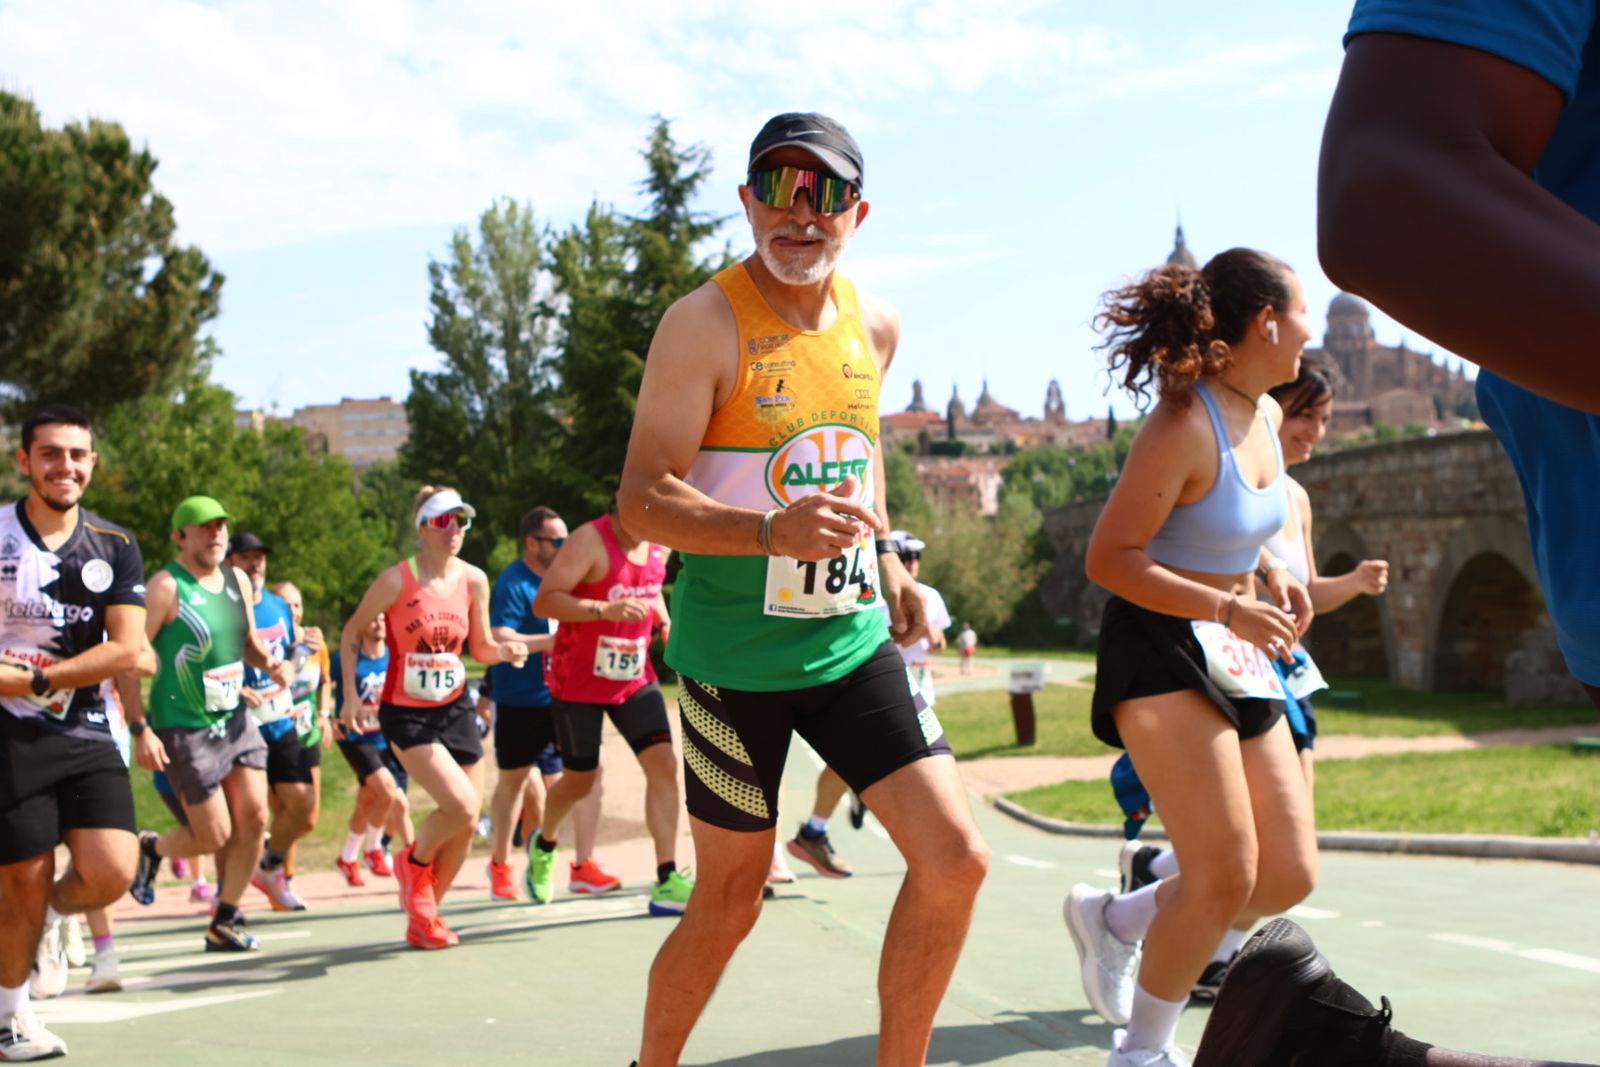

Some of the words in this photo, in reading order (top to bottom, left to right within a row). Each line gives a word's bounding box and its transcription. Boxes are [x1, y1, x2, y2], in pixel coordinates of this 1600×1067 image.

[769, 417, 805, 447] CLUB
[797, 547, 866, 595] 184
[417, 669, 455, 689] 115
